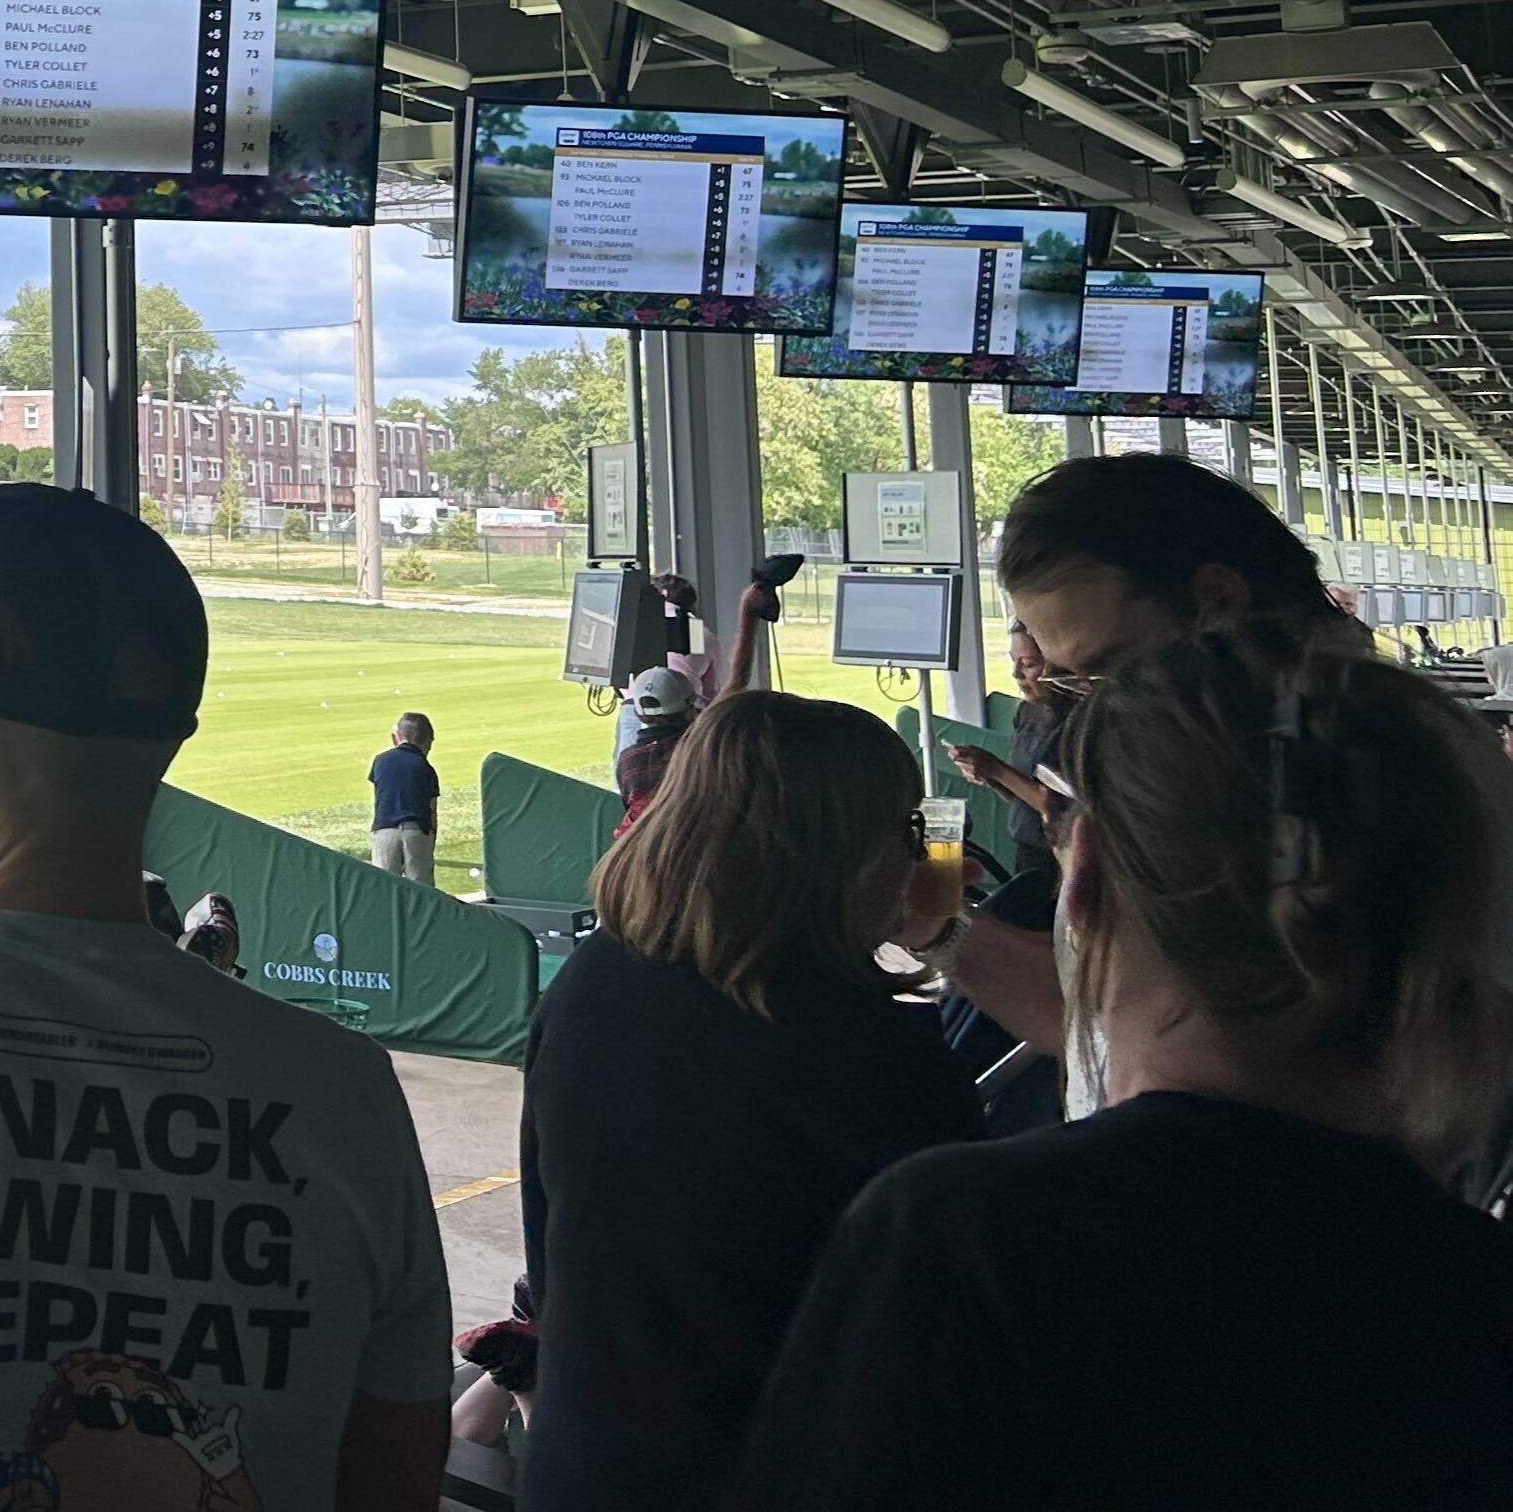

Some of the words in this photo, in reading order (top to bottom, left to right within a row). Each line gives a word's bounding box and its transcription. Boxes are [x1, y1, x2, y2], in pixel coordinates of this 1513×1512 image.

[6, 4, 59, 15] MICHAEL
[62, 5, 101, 16] BLOCK
[208, 10, 222, 21] +5
[248, 12, 261, 21] 75
[5, 23, 35, 33] PAUL
[38, 24, 92, 35] McCLURE
[207, 29, 221, 39] +5
[5, 41, 28, 51] BEN
[31, 42, 87, 53] POLLAND
[206, 48, 220, 58] +6
[246, 50, 259, 58] 73
[5, 60, 39, 70] TYLER
[43, 61, 87, 71] COLLET
[205, 67, 219, 76] +6
[3, 79, 38, 89] CHRIS
[41, 80, 98, 91] GABRIELE
[205, 85, 218, 95] +7
[2, 97, 34, 107] RYAN
[36, 98, 92, 109] LENAHAN
[204, 104, 217, 114] +8
[1, 116, 31, 126] RYAN
[34, 117, 90, 128] VERMEER
[0, 135, 54, 146] GARRETT
[55, 137, 85, 147] SAPP
[242, 143, 254, 152] 74
[607, 132, 625, 140] PGA
[627, 132, 697, 143] CHAMPIONSHIP
[0, 153, 37, 164] DEREK
[40, 154, 72, 165] BERG
[263, 961, 326, 985] COBBS
[328, 968, 391, 990] CREEK
